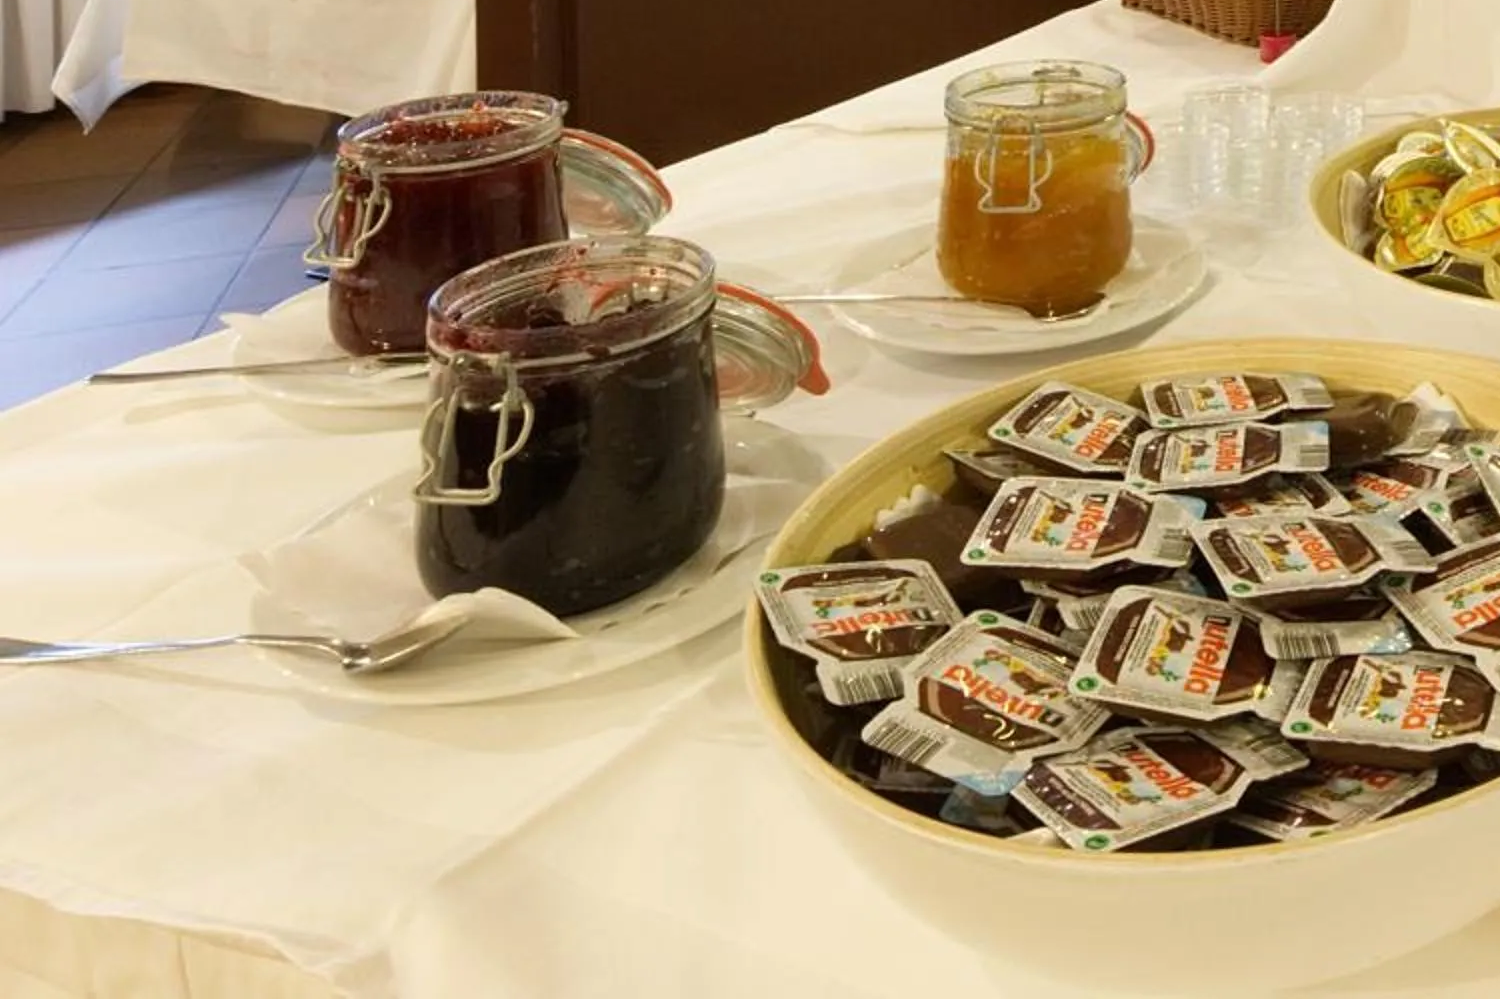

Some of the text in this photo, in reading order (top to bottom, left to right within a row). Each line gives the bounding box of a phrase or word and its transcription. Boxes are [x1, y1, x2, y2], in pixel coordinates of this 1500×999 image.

[1221, 376, 1250, 412] nutella
[1074, 409, 1127, 458] nutella
[1215, 429, 1240, 472] nutella
[1065, 492, 1109, 551] nutella
[1281, 522, 1339, 572] nutella
[1183, 616, 1232, 694] nutella
[943, 664, 1065, 727] nutella
[1401, 665, 1444, 730] nutella
[1108, 741, 1200, 799] nutella
